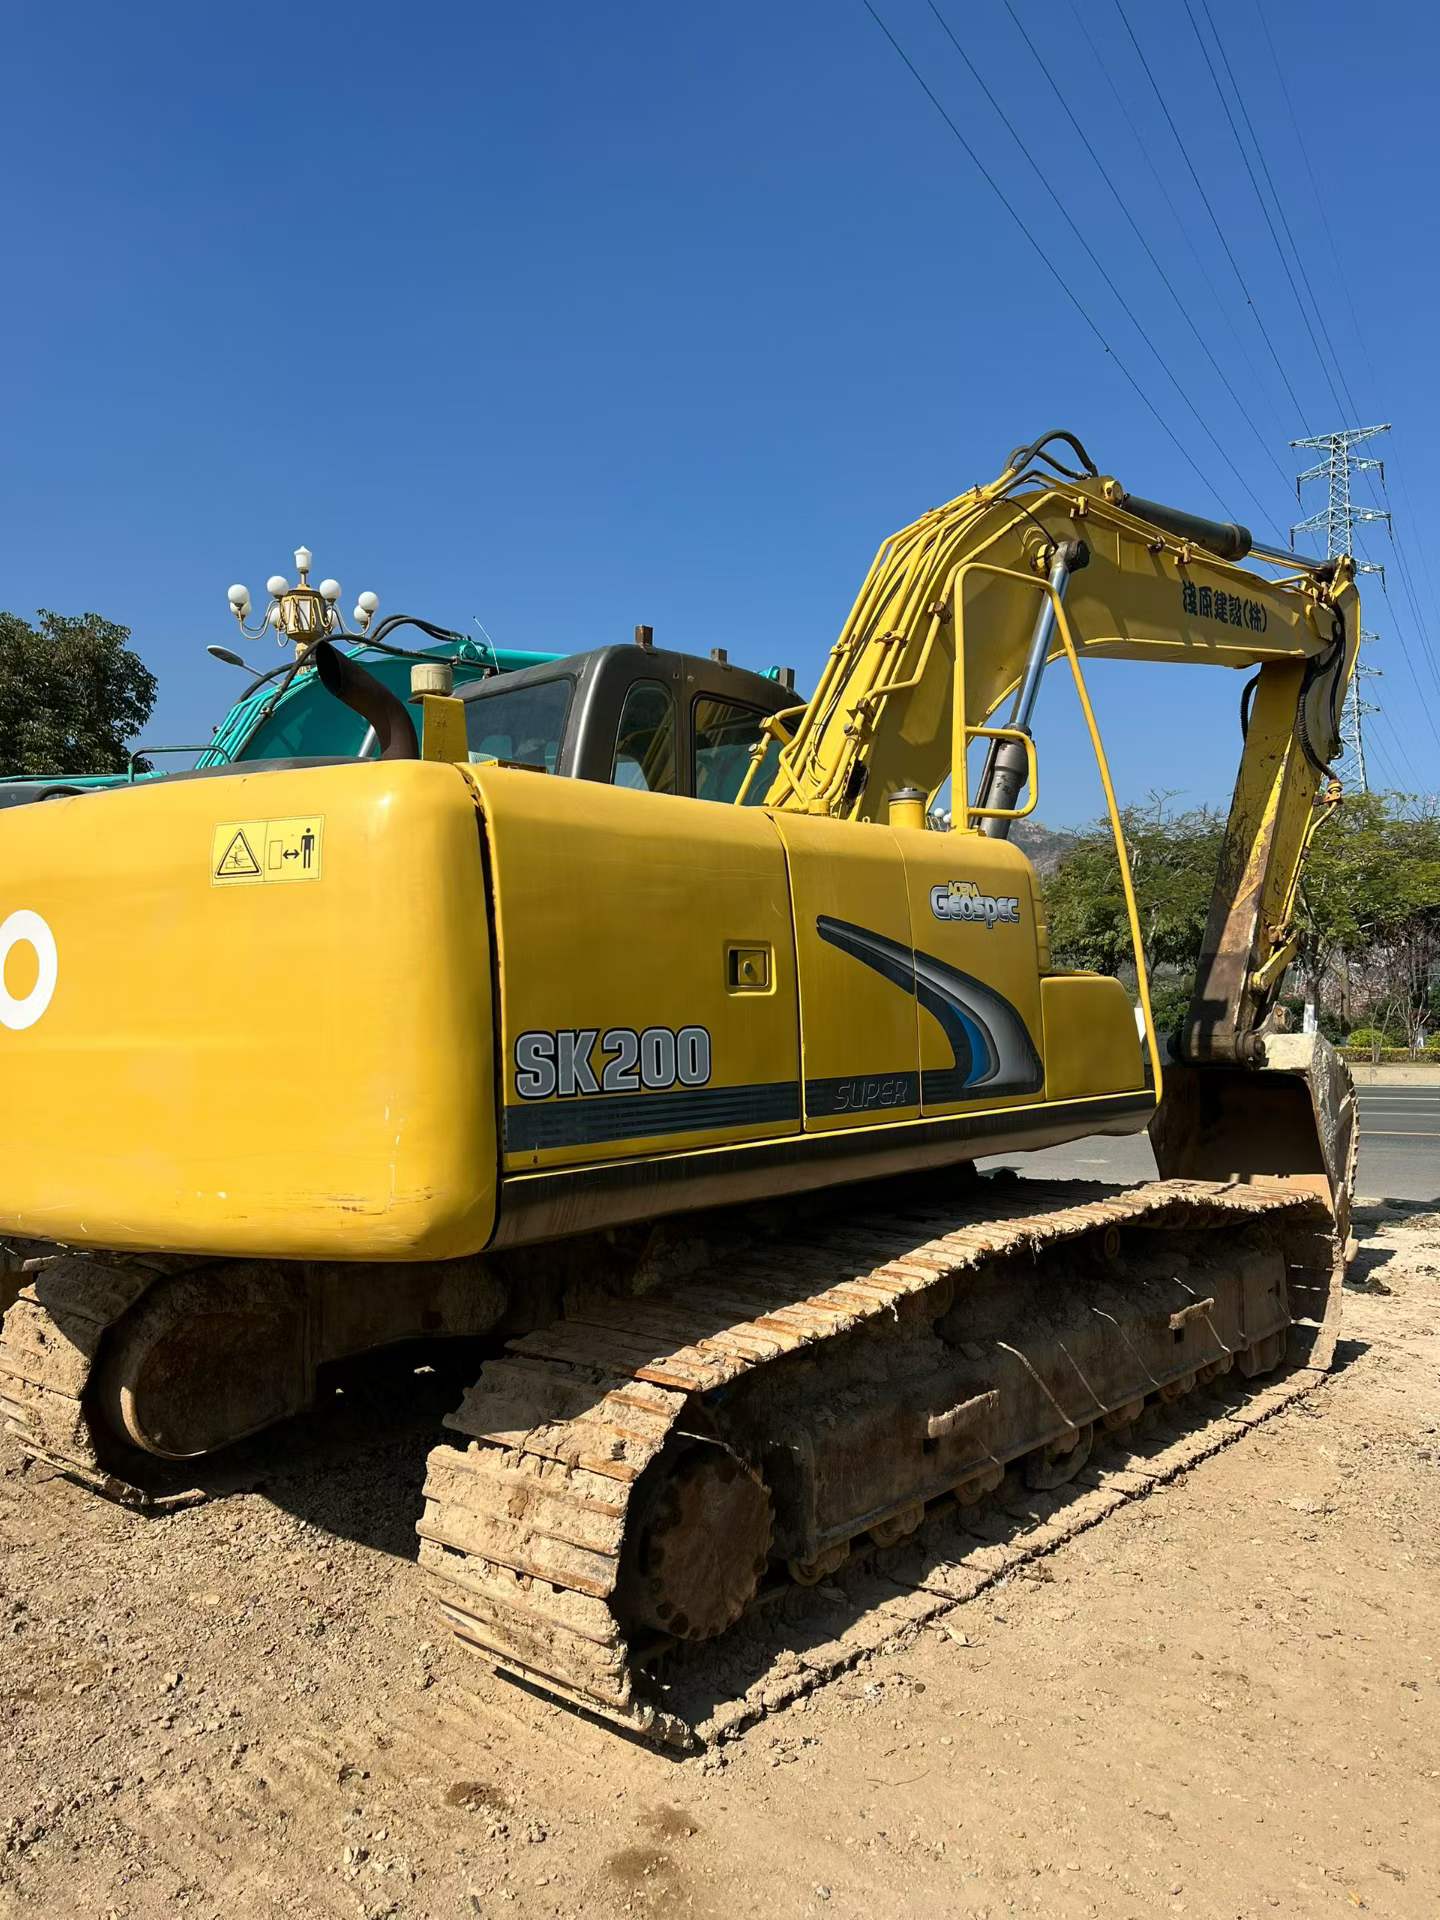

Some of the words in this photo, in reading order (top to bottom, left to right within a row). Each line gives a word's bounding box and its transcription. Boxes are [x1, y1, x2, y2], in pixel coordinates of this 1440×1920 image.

[930, 885, 1020, 929] Geospec
[515, 1025, 711, 1100] SK200
[832, 1078, 908, 1111] SUPER
